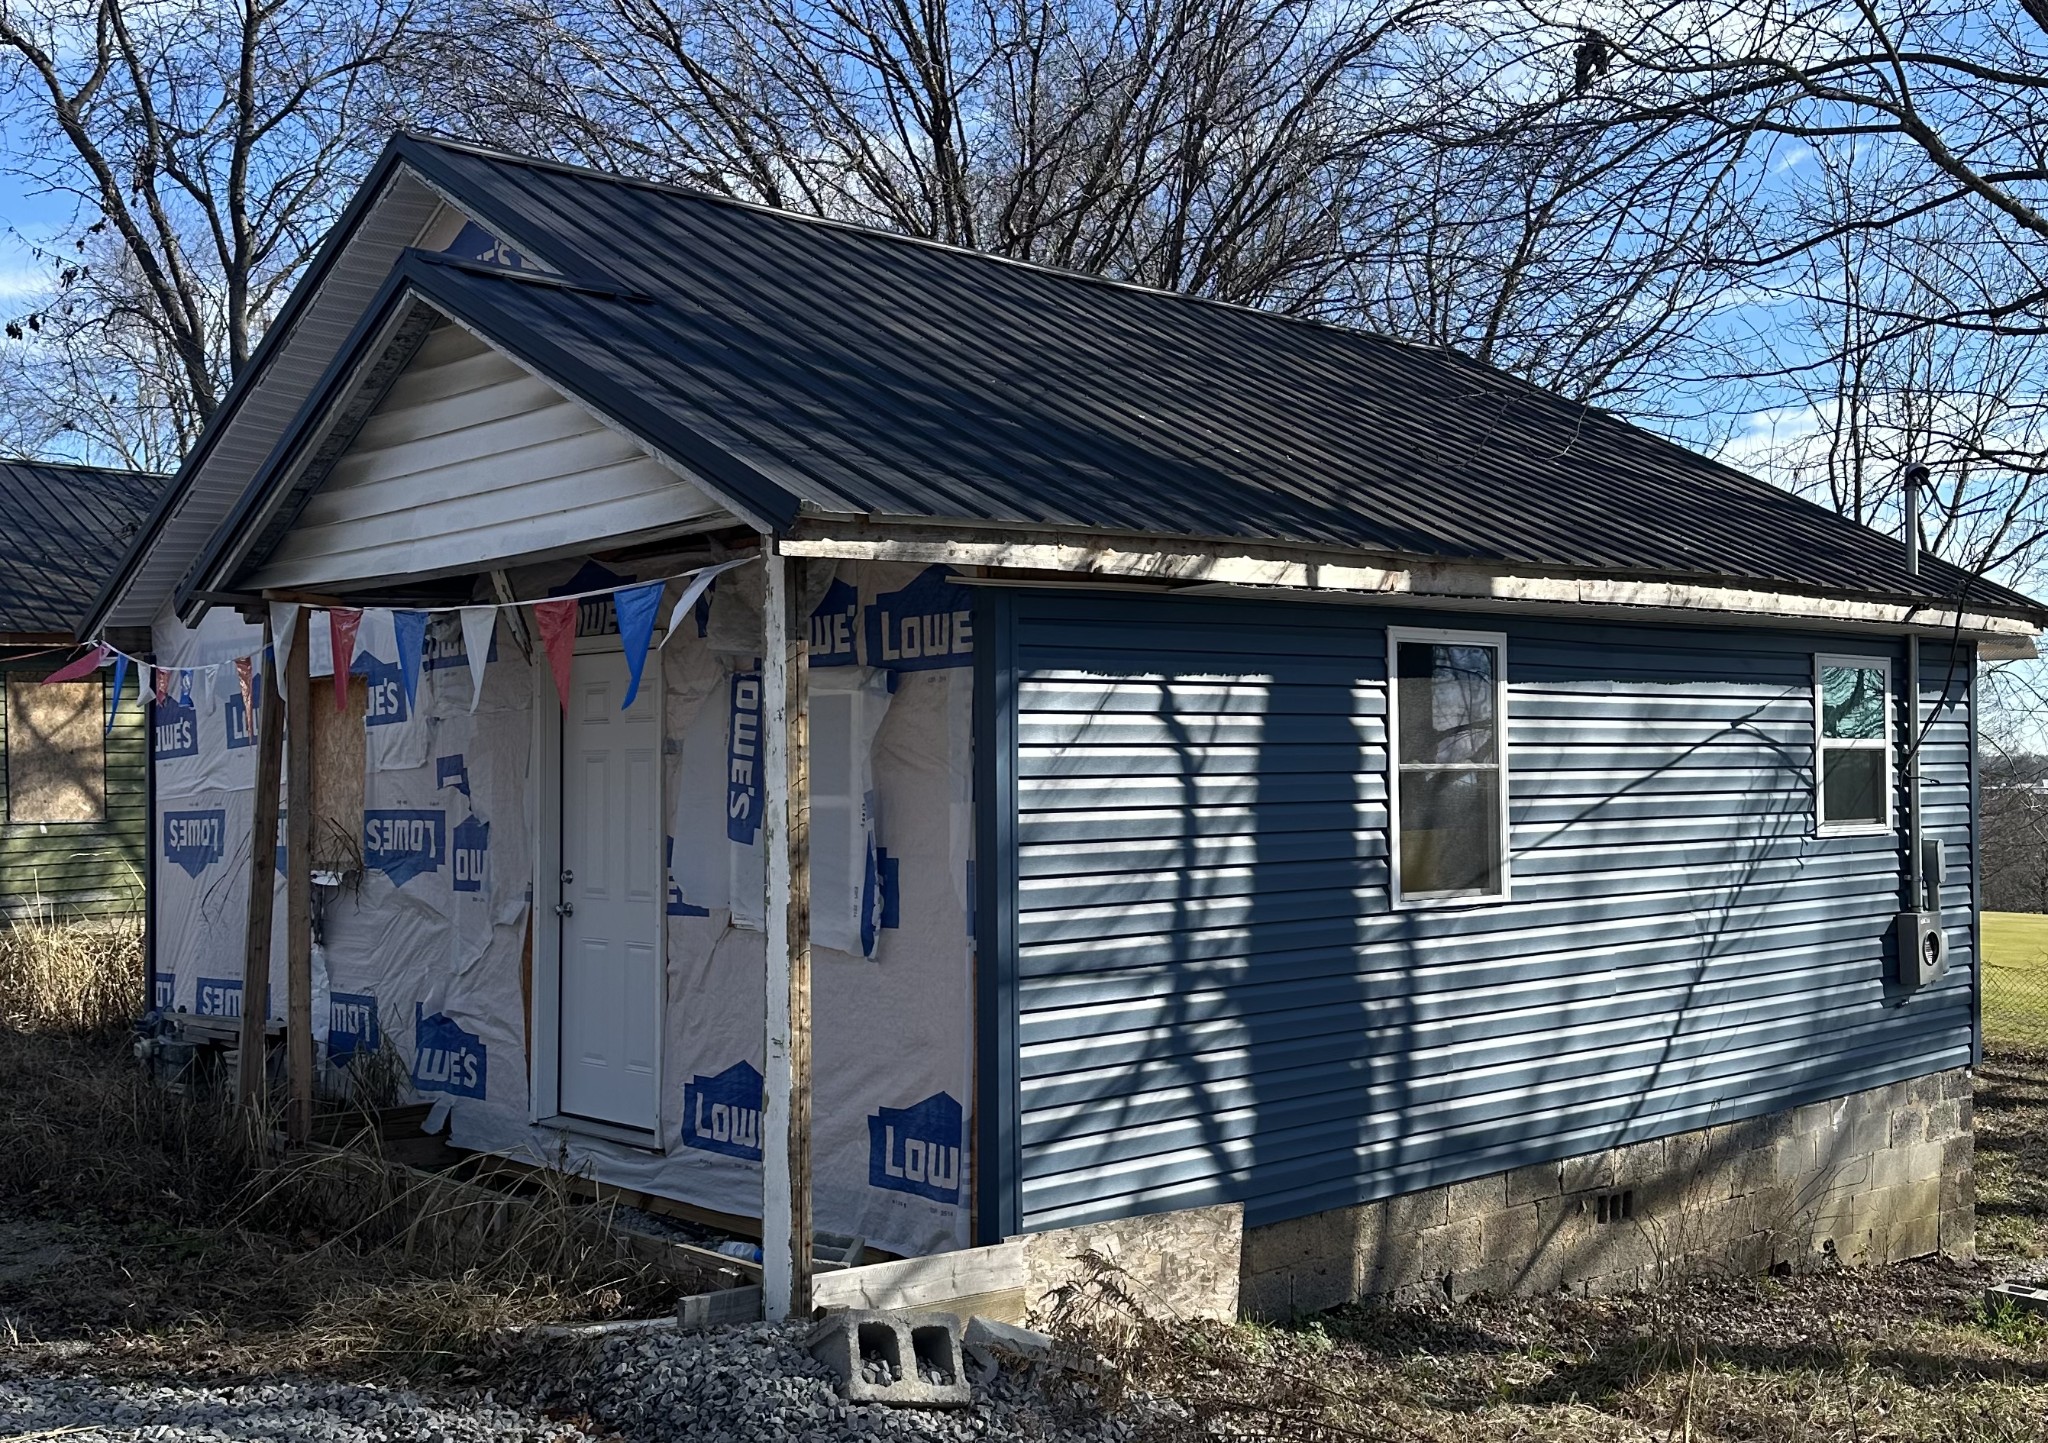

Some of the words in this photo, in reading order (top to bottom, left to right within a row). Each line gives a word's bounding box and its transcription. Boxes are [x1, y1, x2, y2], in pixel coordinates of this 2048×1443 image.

[729, 679, 759, 820] OWE'S
[169, 818, 219, 852] LOWE'S
[366, 818, 437, 859] LOWE'S
[417, 1046, 478, 1089] WE'S
